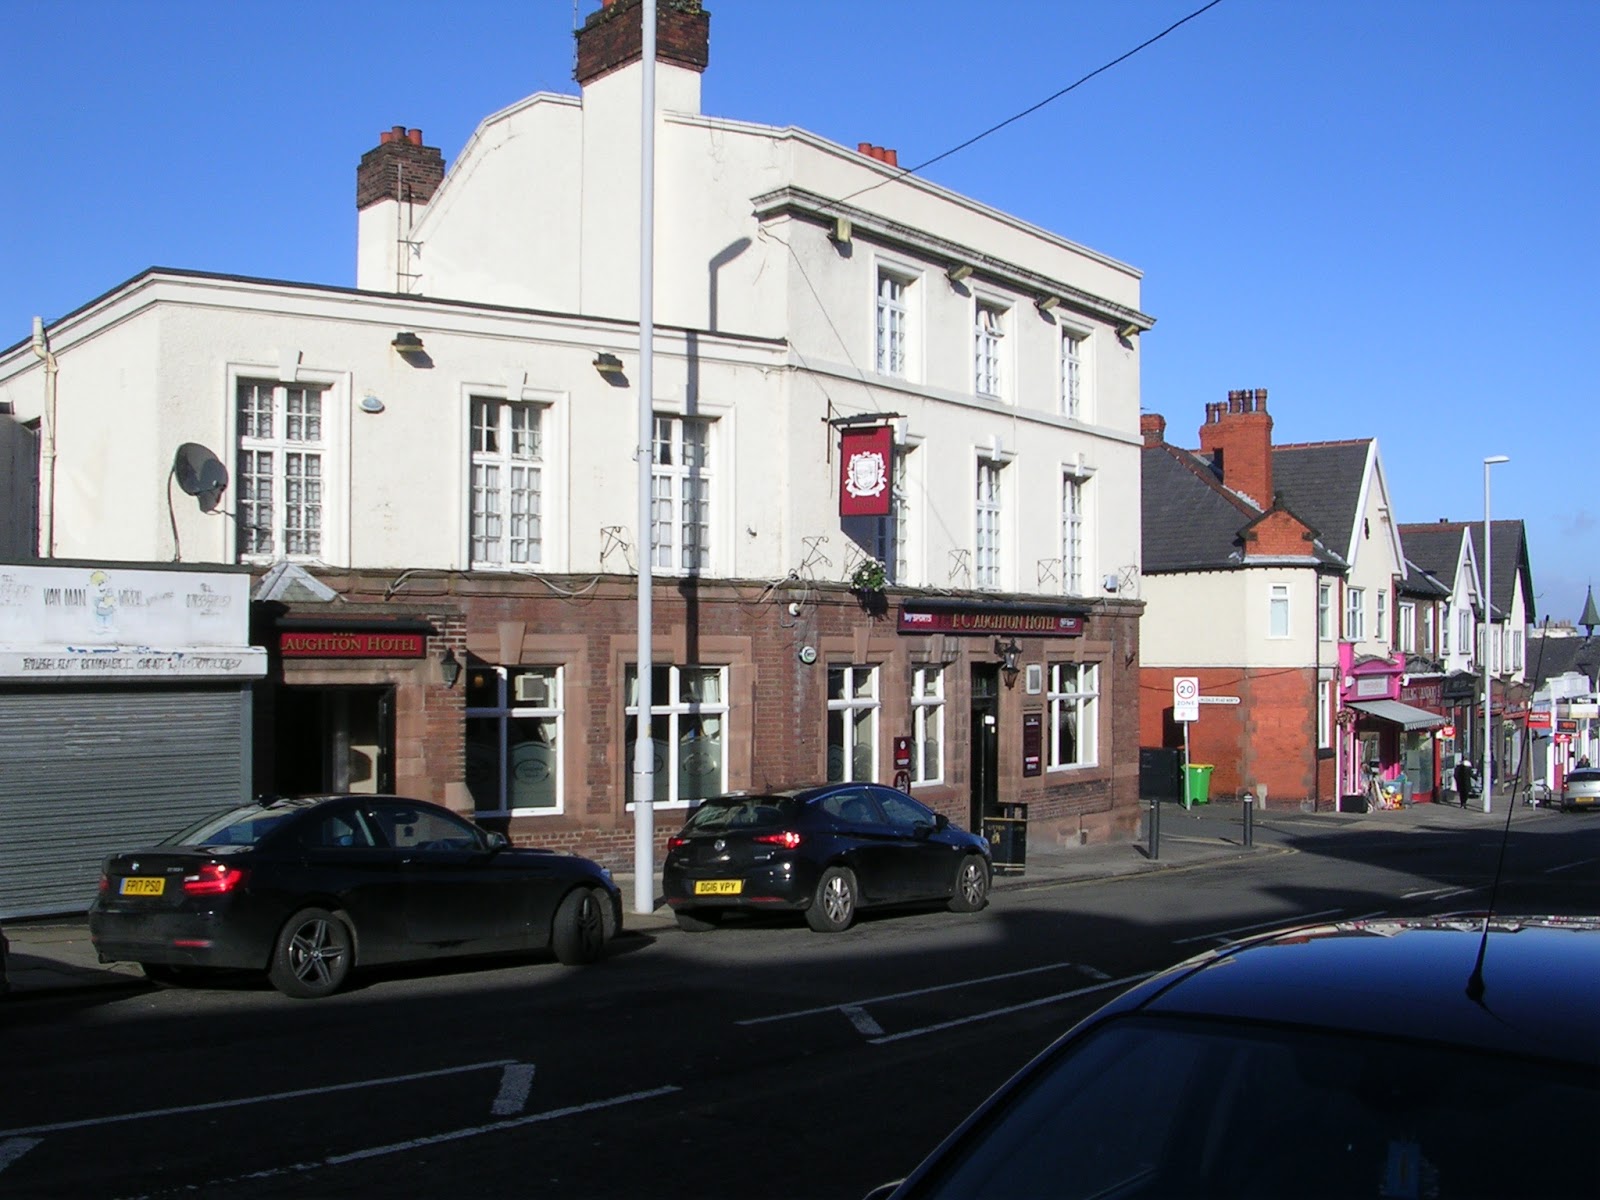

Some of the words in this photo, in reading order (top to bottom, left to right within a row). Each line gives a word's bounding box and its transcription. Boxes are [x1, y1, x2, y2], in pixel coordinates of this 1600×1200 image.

[43, 588, 61, 606] VAN
[64, 588, 87, 606] MAN
[1025, 614, 1056, 630] HOTEL
[282, 638, 362, 651] AUGHTON
[367, 637, 417, 651] HOTEL
[1180, 685, 1193, 694] 20
[700, 883, 717, 892] DG16
[720, 882, 737, 891] VPY
